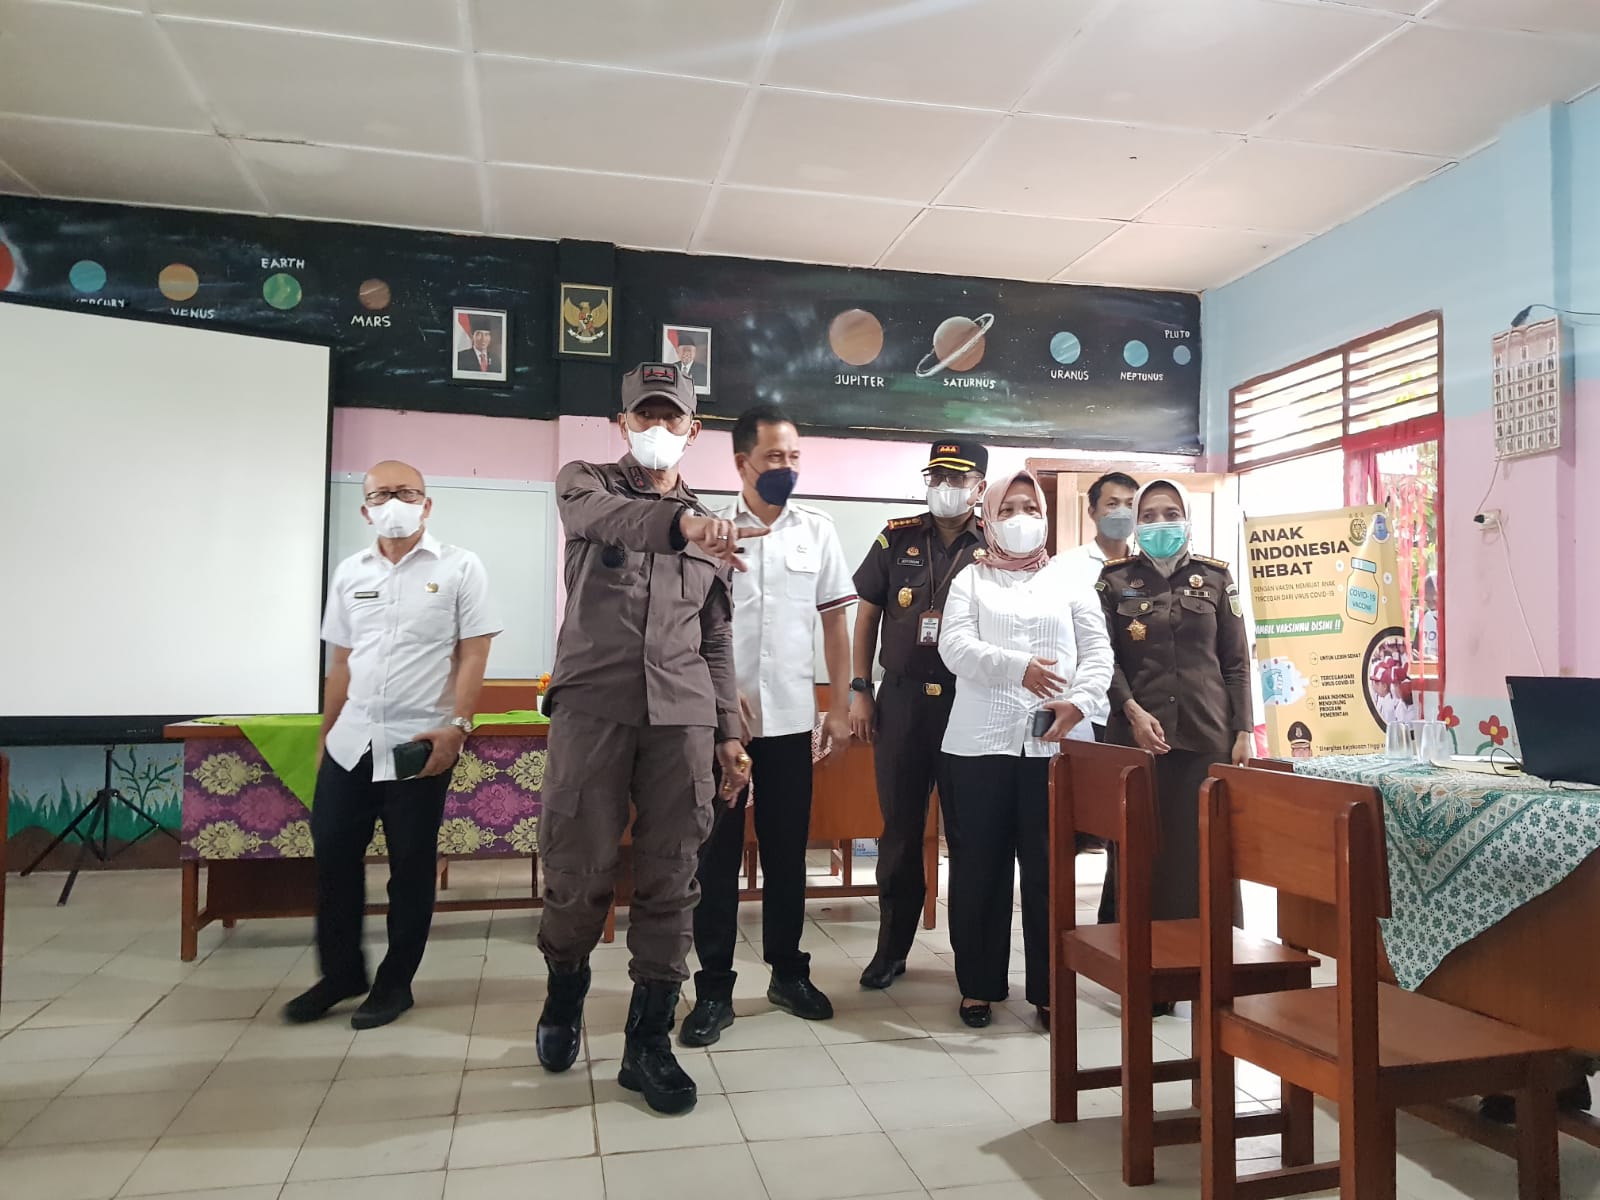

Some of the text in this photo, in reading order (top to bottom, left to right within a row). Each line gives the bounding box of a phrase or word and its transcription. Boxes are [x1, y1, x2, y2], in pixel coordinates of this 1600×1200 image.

[261, 258, 305, 269] EARTH
[350, 315, 392, 327] MARS
[1164, 329, 1191, 339] PLUTO
[834, 374, 885, 387] JUPITER
[1050, 369, 1089, 381] URANUS
[1119, 372, 1164, 382] NEPTUNUS
[943, 377, 997, 390] SATURNUS
[1249, 526, 1304, 544] ANAK
[1250, 540, 1350, 561] INDONESIA
[1252, 561, 1313, 579] HEBAT
[1349, 587, 1376, 602] COVID-19
